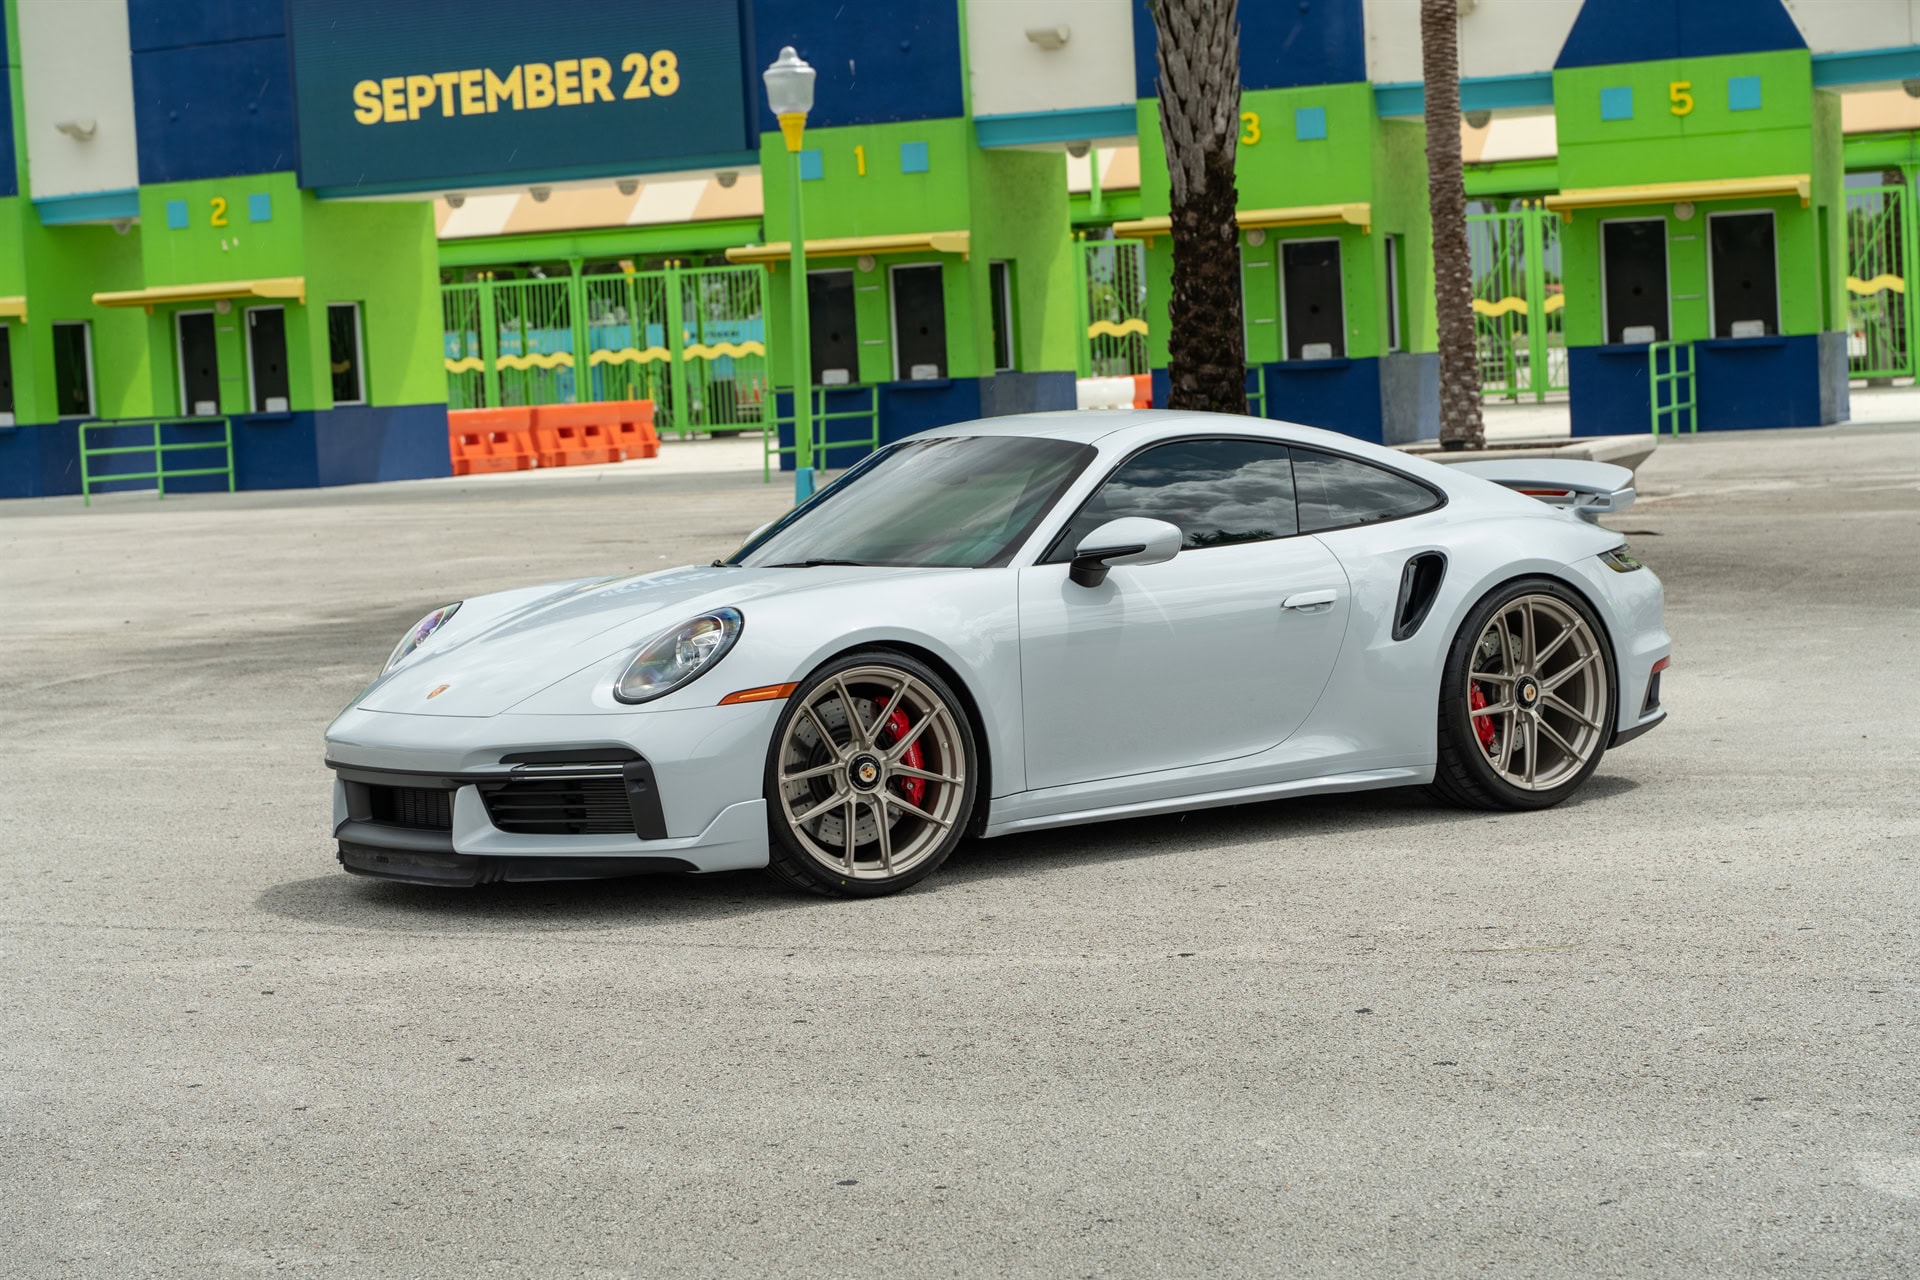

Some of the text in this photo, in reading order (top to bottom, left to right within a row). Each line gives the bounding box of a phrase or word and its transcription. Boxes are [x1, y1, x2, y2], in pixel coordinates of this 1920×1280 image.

[353, 49, 680, 125] SEPTEMBER 28
[1670, 81, 1693, 116] 5
[1240, 111, 1260, 145] 3
[853, 145, 866, 177] 1
[211, 196, 228, 226] 2
